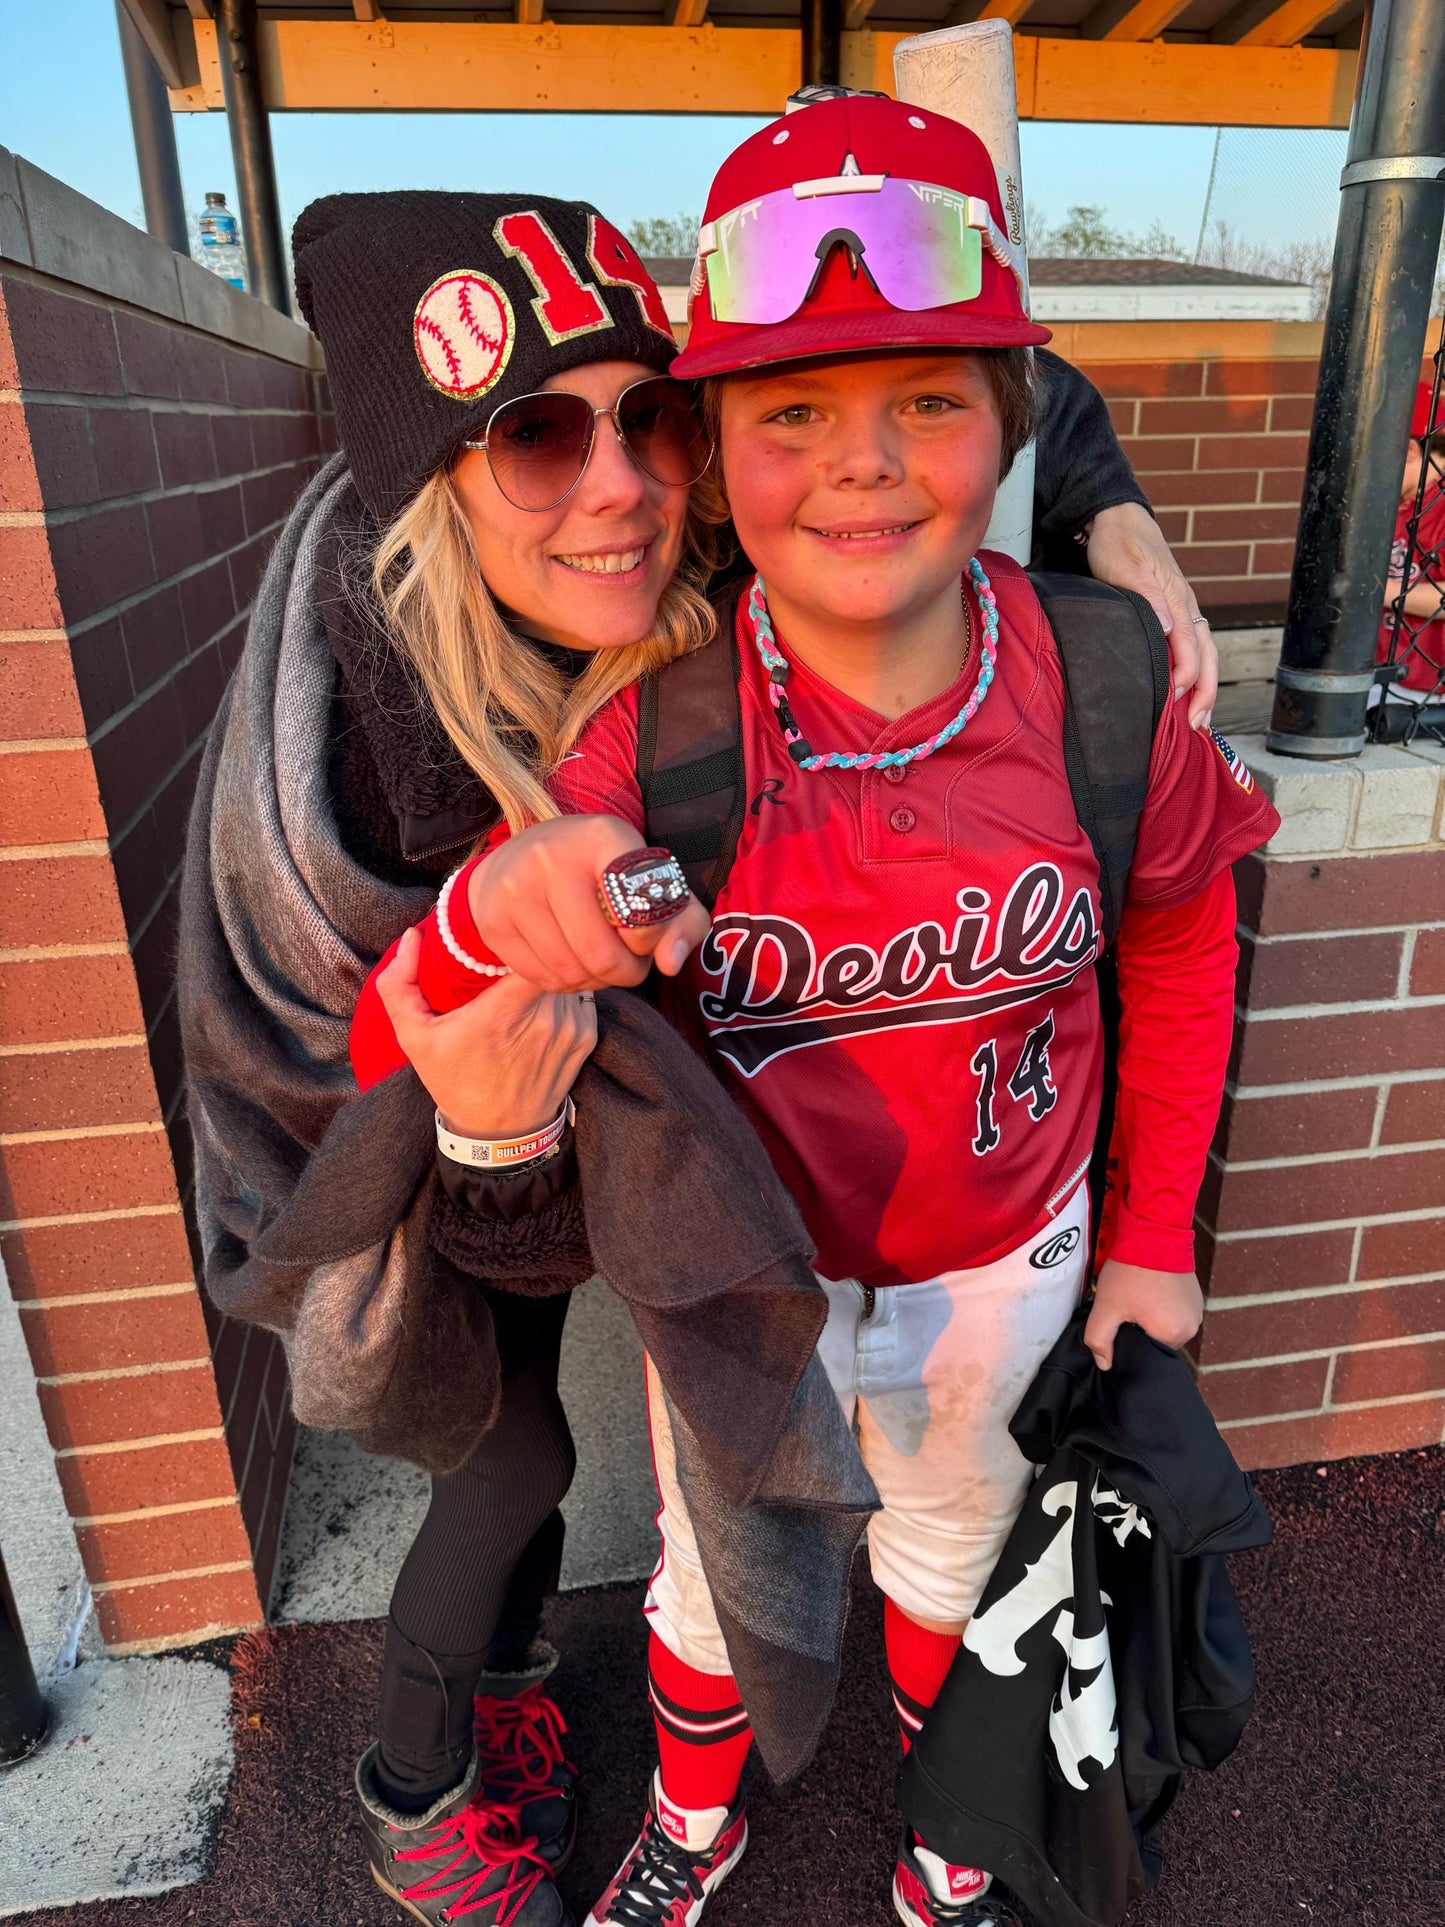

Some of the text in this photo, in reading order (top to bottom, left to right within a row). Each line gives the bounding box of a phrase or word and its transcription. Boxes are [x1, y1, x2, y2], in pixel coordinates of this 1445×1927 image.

[908, 183, 964, 250] VIPER
[1005, 175, 1021, 246] Rawlings
[491, 210, 679, 347] 14
[700, 861, 1101, 1022] Devils
[969, 1008, 1058, 1156] 14
[497, 1142, 536, 1158] BULLPEN
[955, 1869, 974, 1882] NIKE
